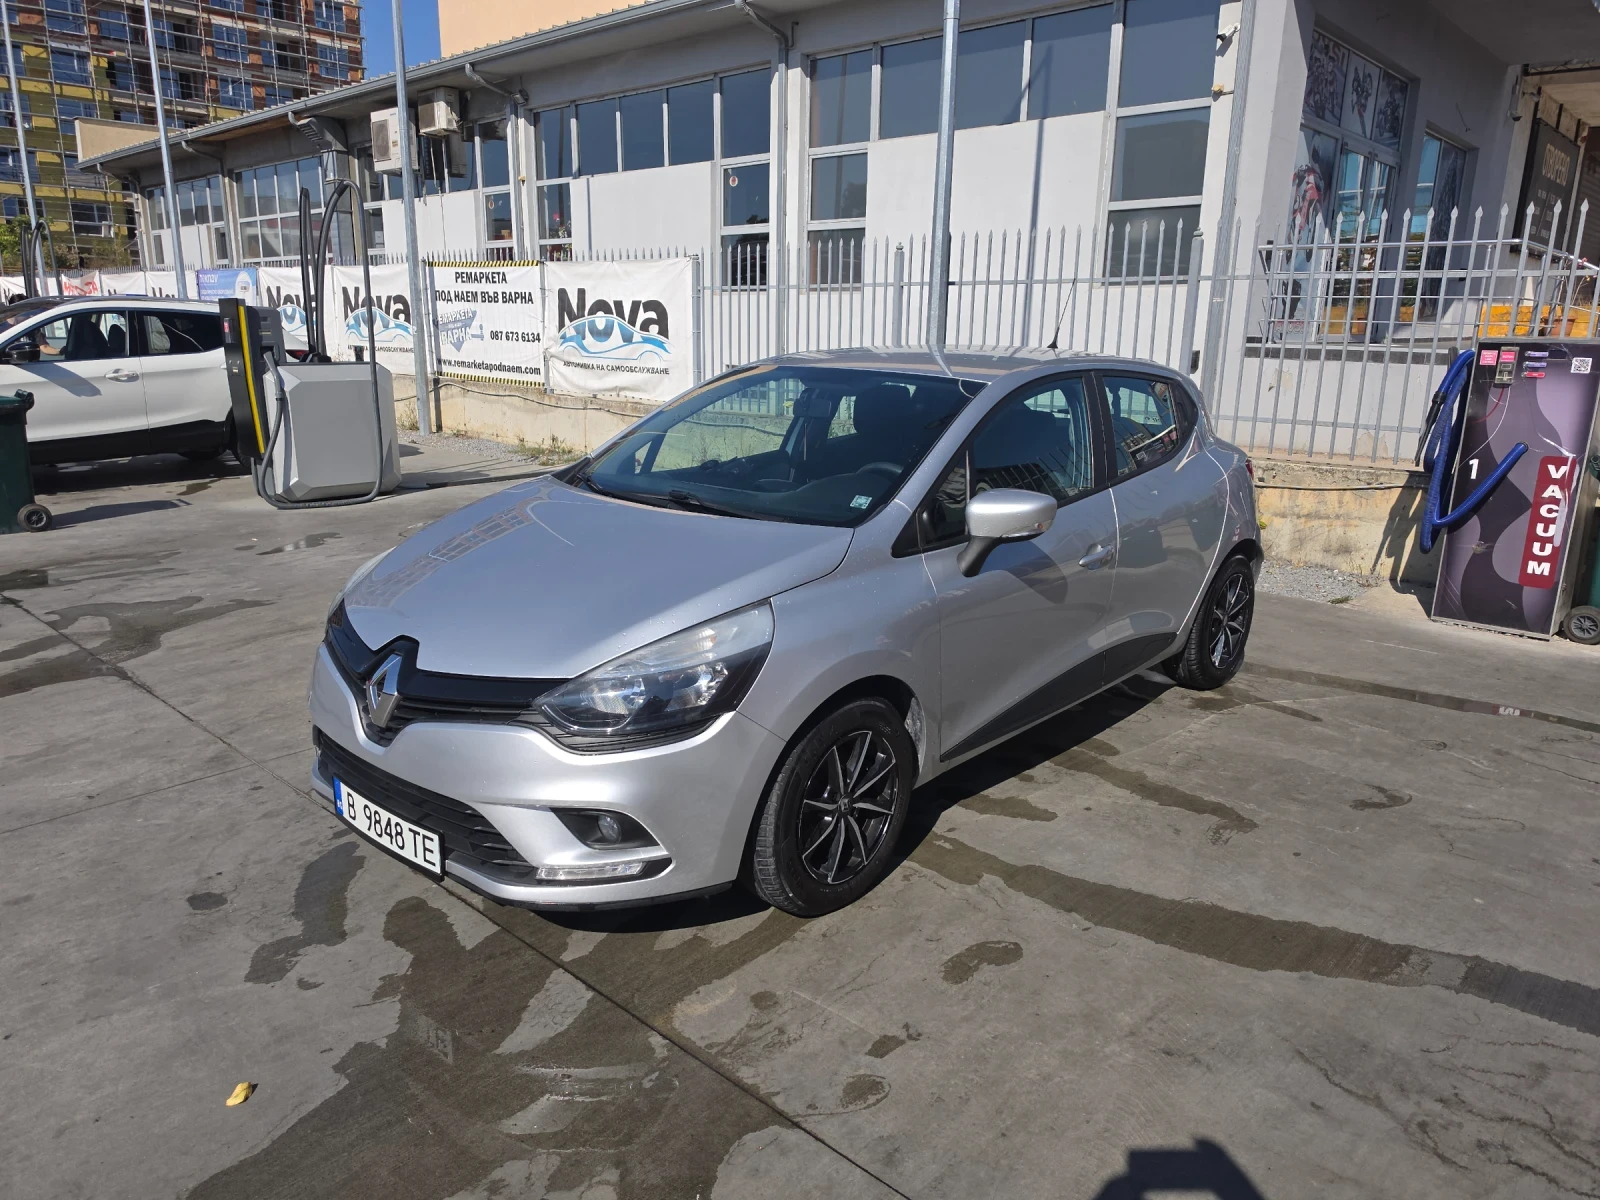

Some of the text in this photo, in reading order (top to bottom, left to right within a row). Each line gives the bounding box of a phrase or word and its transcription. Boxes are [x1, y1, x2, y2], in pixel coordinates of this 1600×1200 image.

[455, 271, 507, 284] РЕМАРКЕТА
[435, 290, 534, 305] ПОД НАЕМ ВЪВ ВАРНА
[342, 286, 411, 328] Nova
[558, 287, 669, 343] Nova
[437, 308, 473, 326] ЕМАРКЕТА
[490, 330, 541, 343] 087 673 6134
[437, 358, 541, 376] www.remarketapodnaem.com
[596, 363, 606, 371] НА
[606, 364, 670, 375] САМООБСЛУЖВАНЕ
[1469, 458, 1479, 480] 1
[1526, 464, 1567, 577] VACUUM
[346, 791, 436, 867] B 9848 TE
